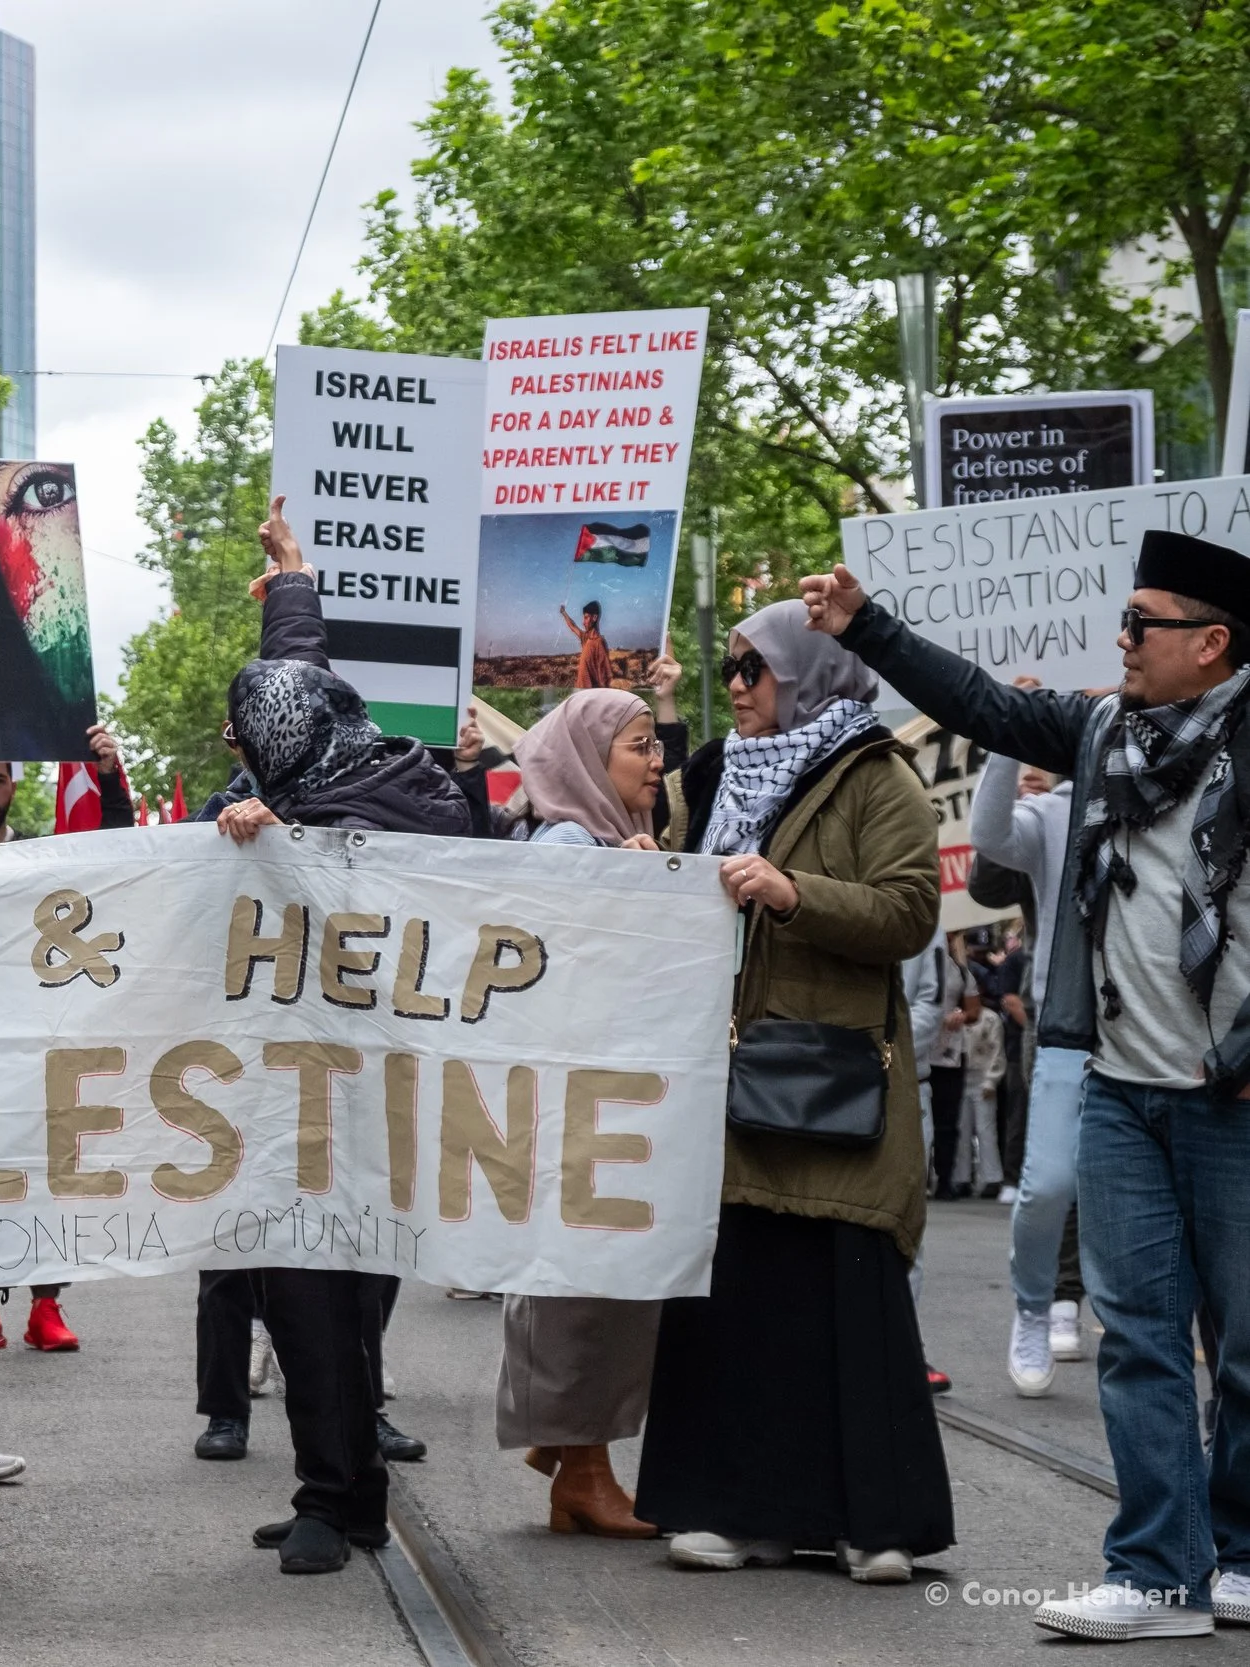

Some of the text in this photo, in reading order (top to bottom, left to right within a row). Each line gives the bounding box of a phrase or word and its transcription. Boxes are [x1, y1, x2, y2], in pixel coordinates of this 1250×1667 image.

[489, 330, 699, 361] ISRAELIS FELT LIKE
[315, 370, 437, 405] ISRAEL
[510, 369, 664, 396] PALESTINIANS
[490, 405, 675, 432] FOR A DAY AND &
[332, 421, 415, 453] WILL
[952, 423, 1066, 451] Power in
[621, 442, 680, 464] THEY
[952, 449, 1090, 480] defense of
[314, 469, 429, 504] NEVER
[572, 481, 622, 503] LIKE
[628, 480, 651, 501] IT
[1154, 490, 1208, 537] TO
[313, 519, 426, 553] ERASE
[316, 569, 461, 605] LESTINE
[31, 888, 126, 989] &
[225, 895, 549, 1024] HELP
